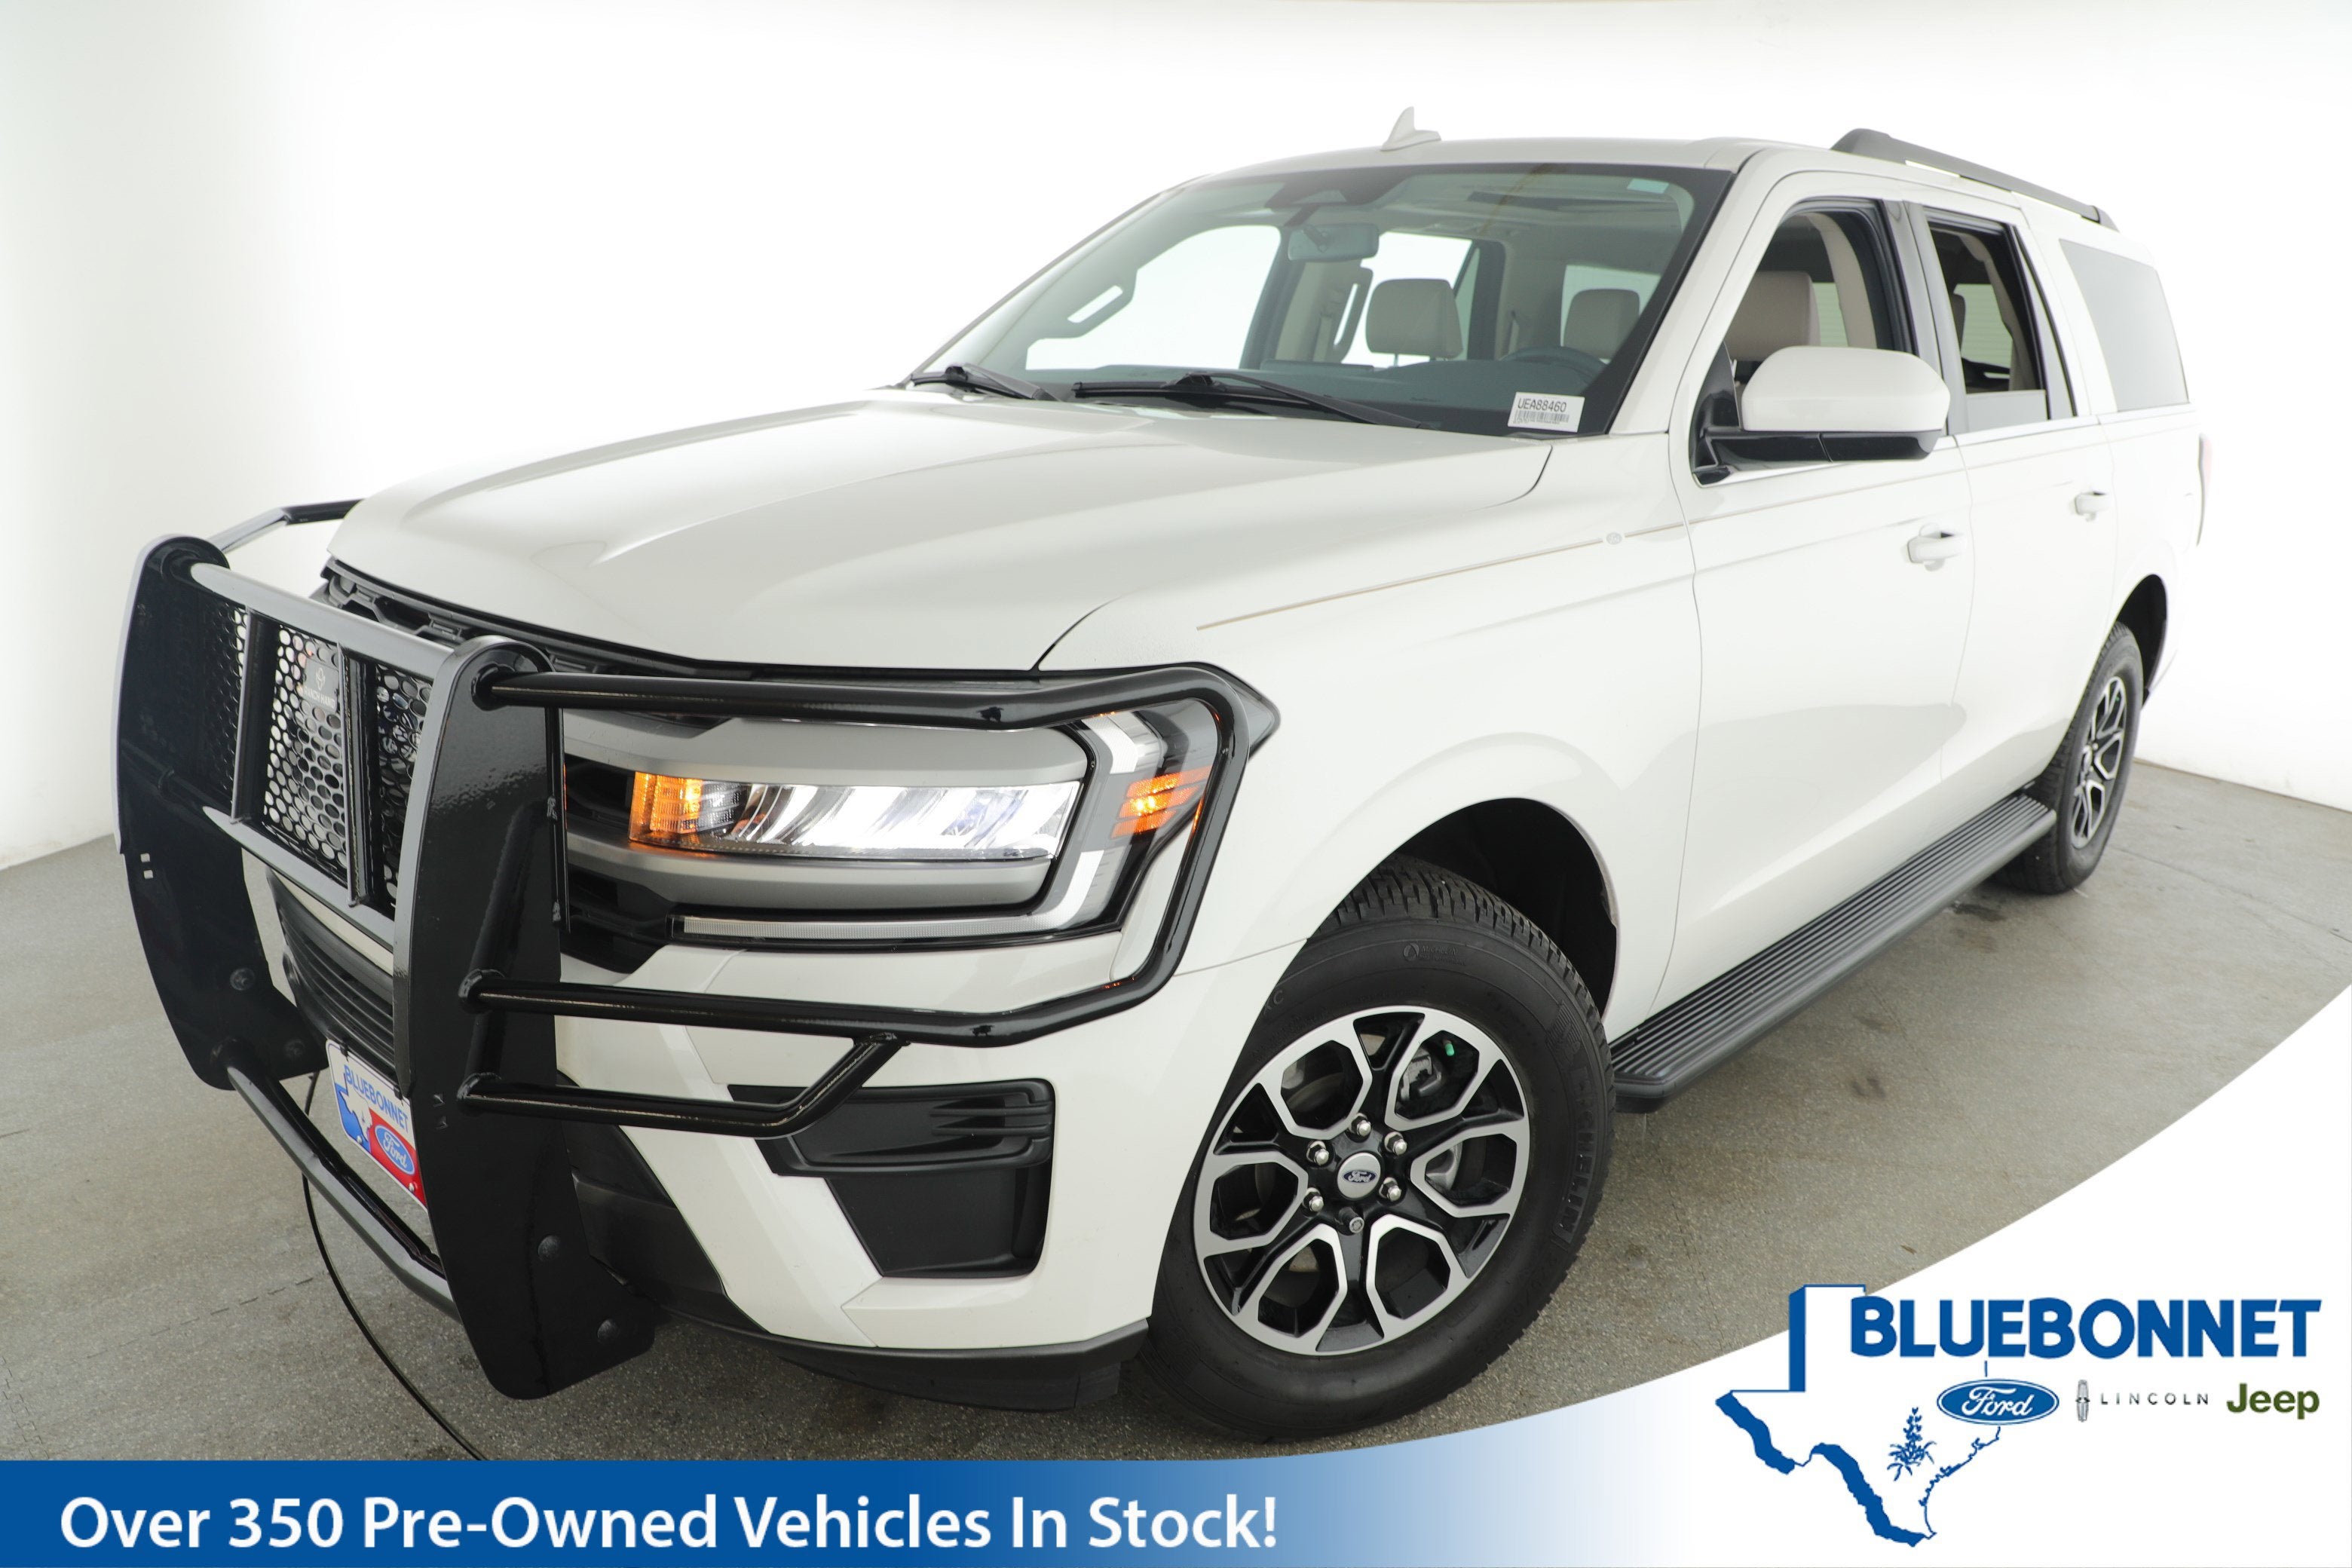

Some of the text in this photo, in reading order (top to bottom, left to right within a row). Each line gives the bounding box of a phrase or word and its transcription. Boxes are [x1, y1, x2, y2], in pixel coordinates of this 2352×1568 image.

[1517, 398, 1567, 412] UEA88460
[344, 1064, 409, 1134] BLUEBONNET
[381, 1130, 409, 1169] Ford
[1347, 1170, 1372, 1183] Ford
